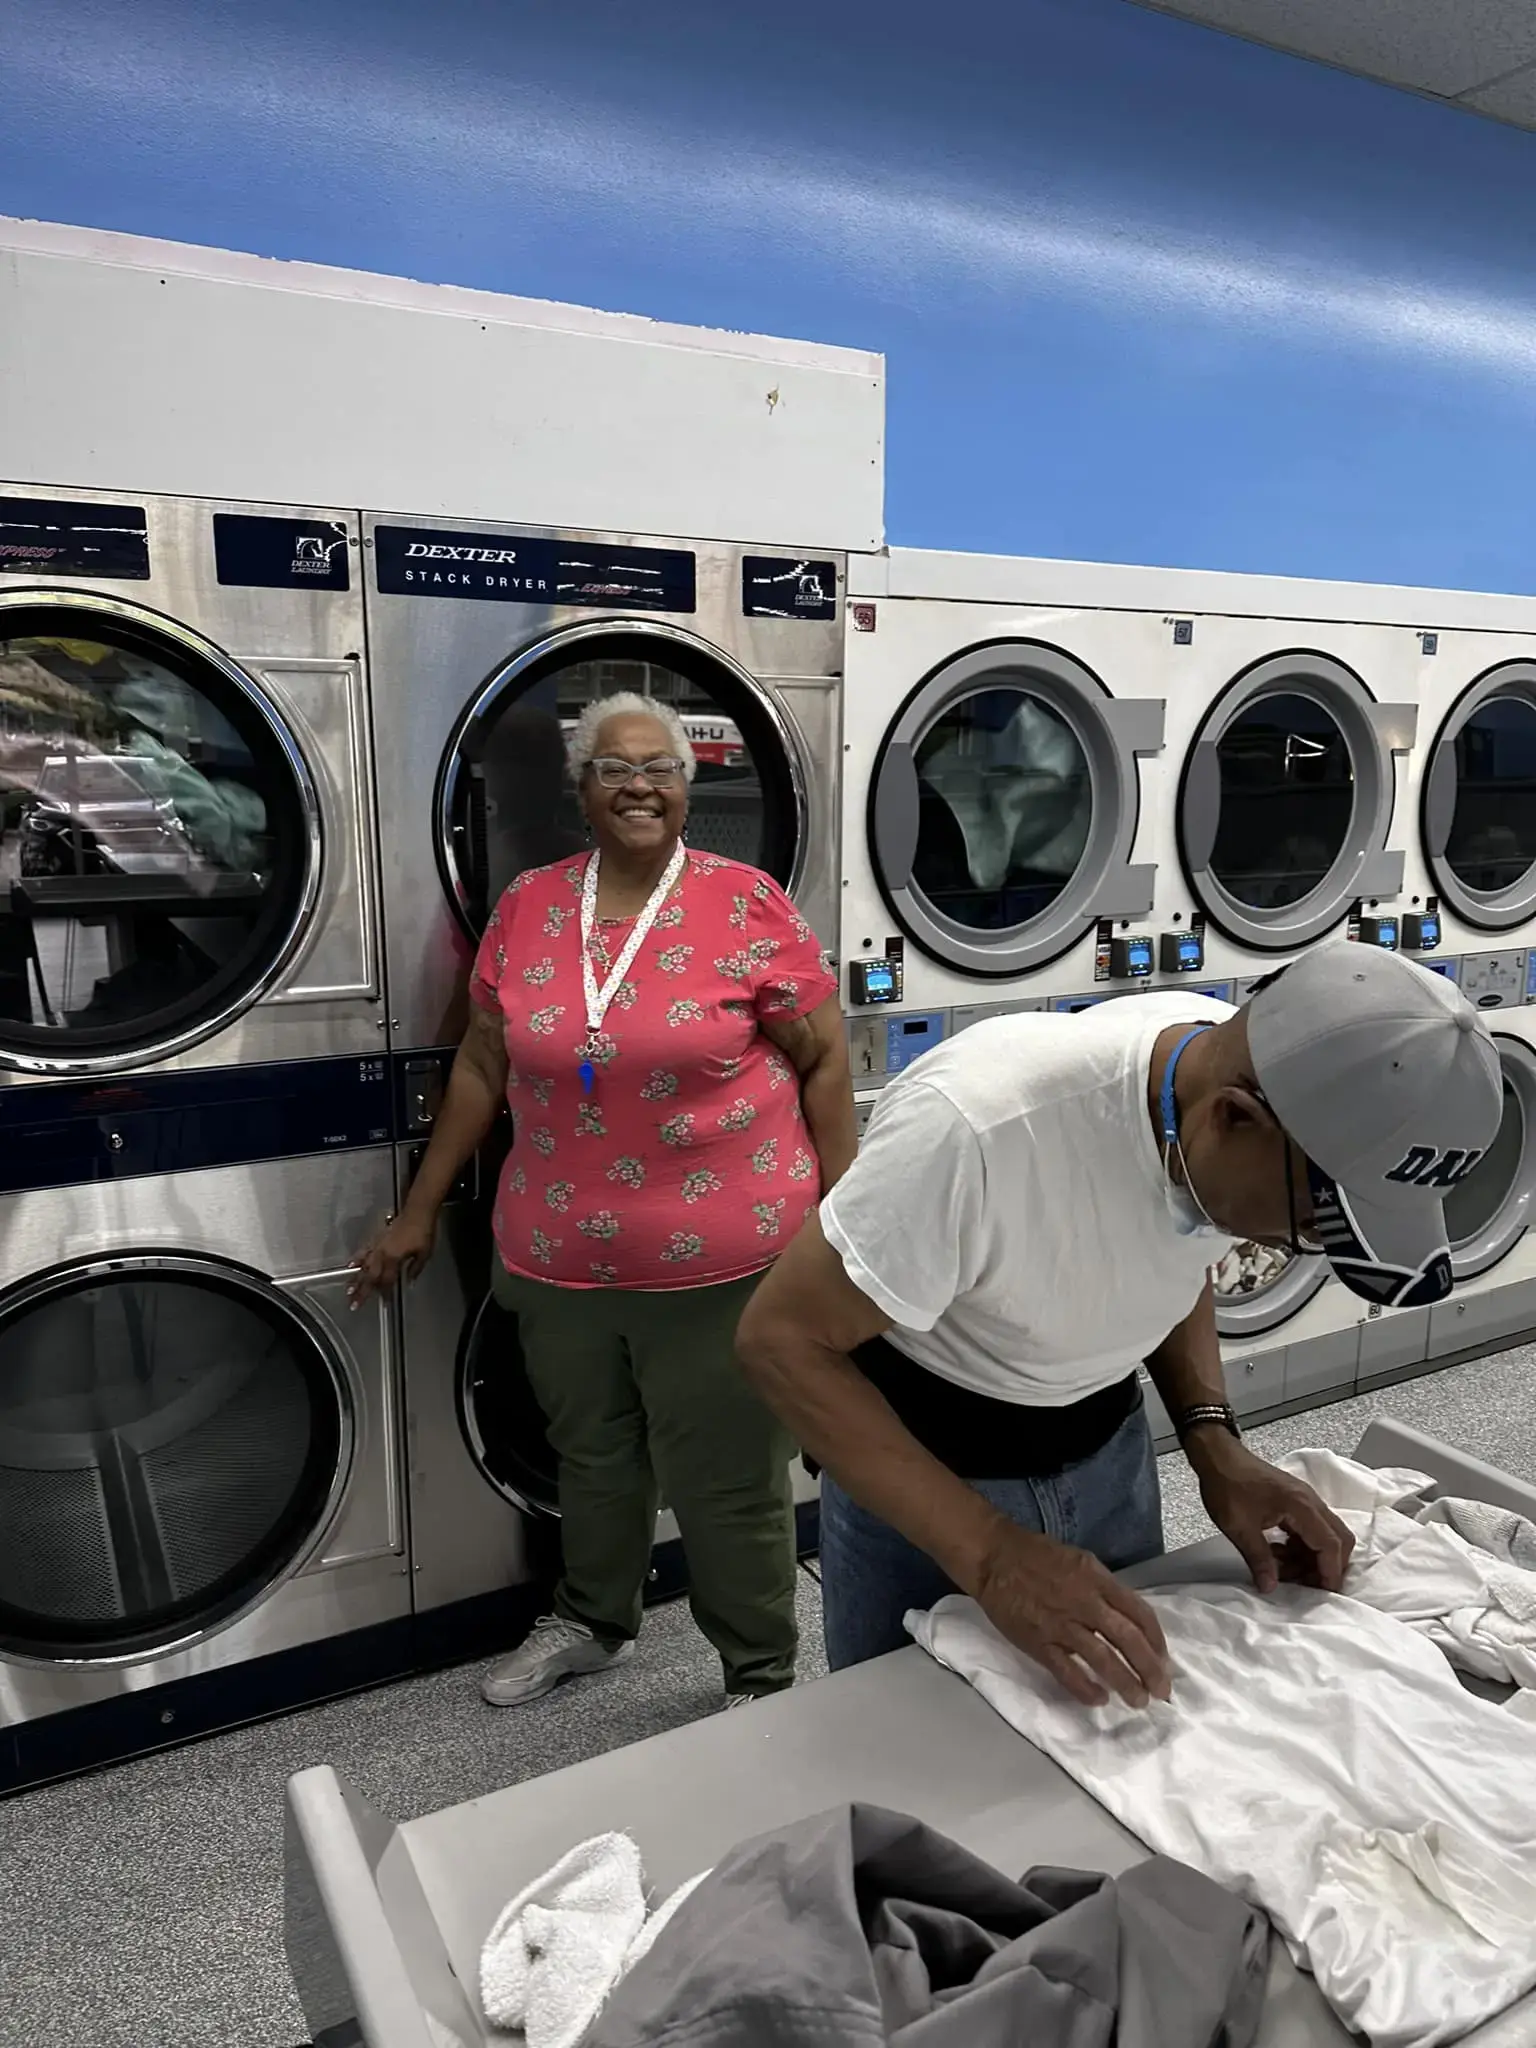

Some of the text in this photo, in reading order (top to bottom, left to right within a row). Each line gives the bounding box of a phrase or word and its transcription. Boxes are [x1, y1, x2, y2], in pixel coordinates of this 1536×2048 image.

[405, 543, 517, 564] DEXTER
[405, 570, 547, 590] STACK DRYER
